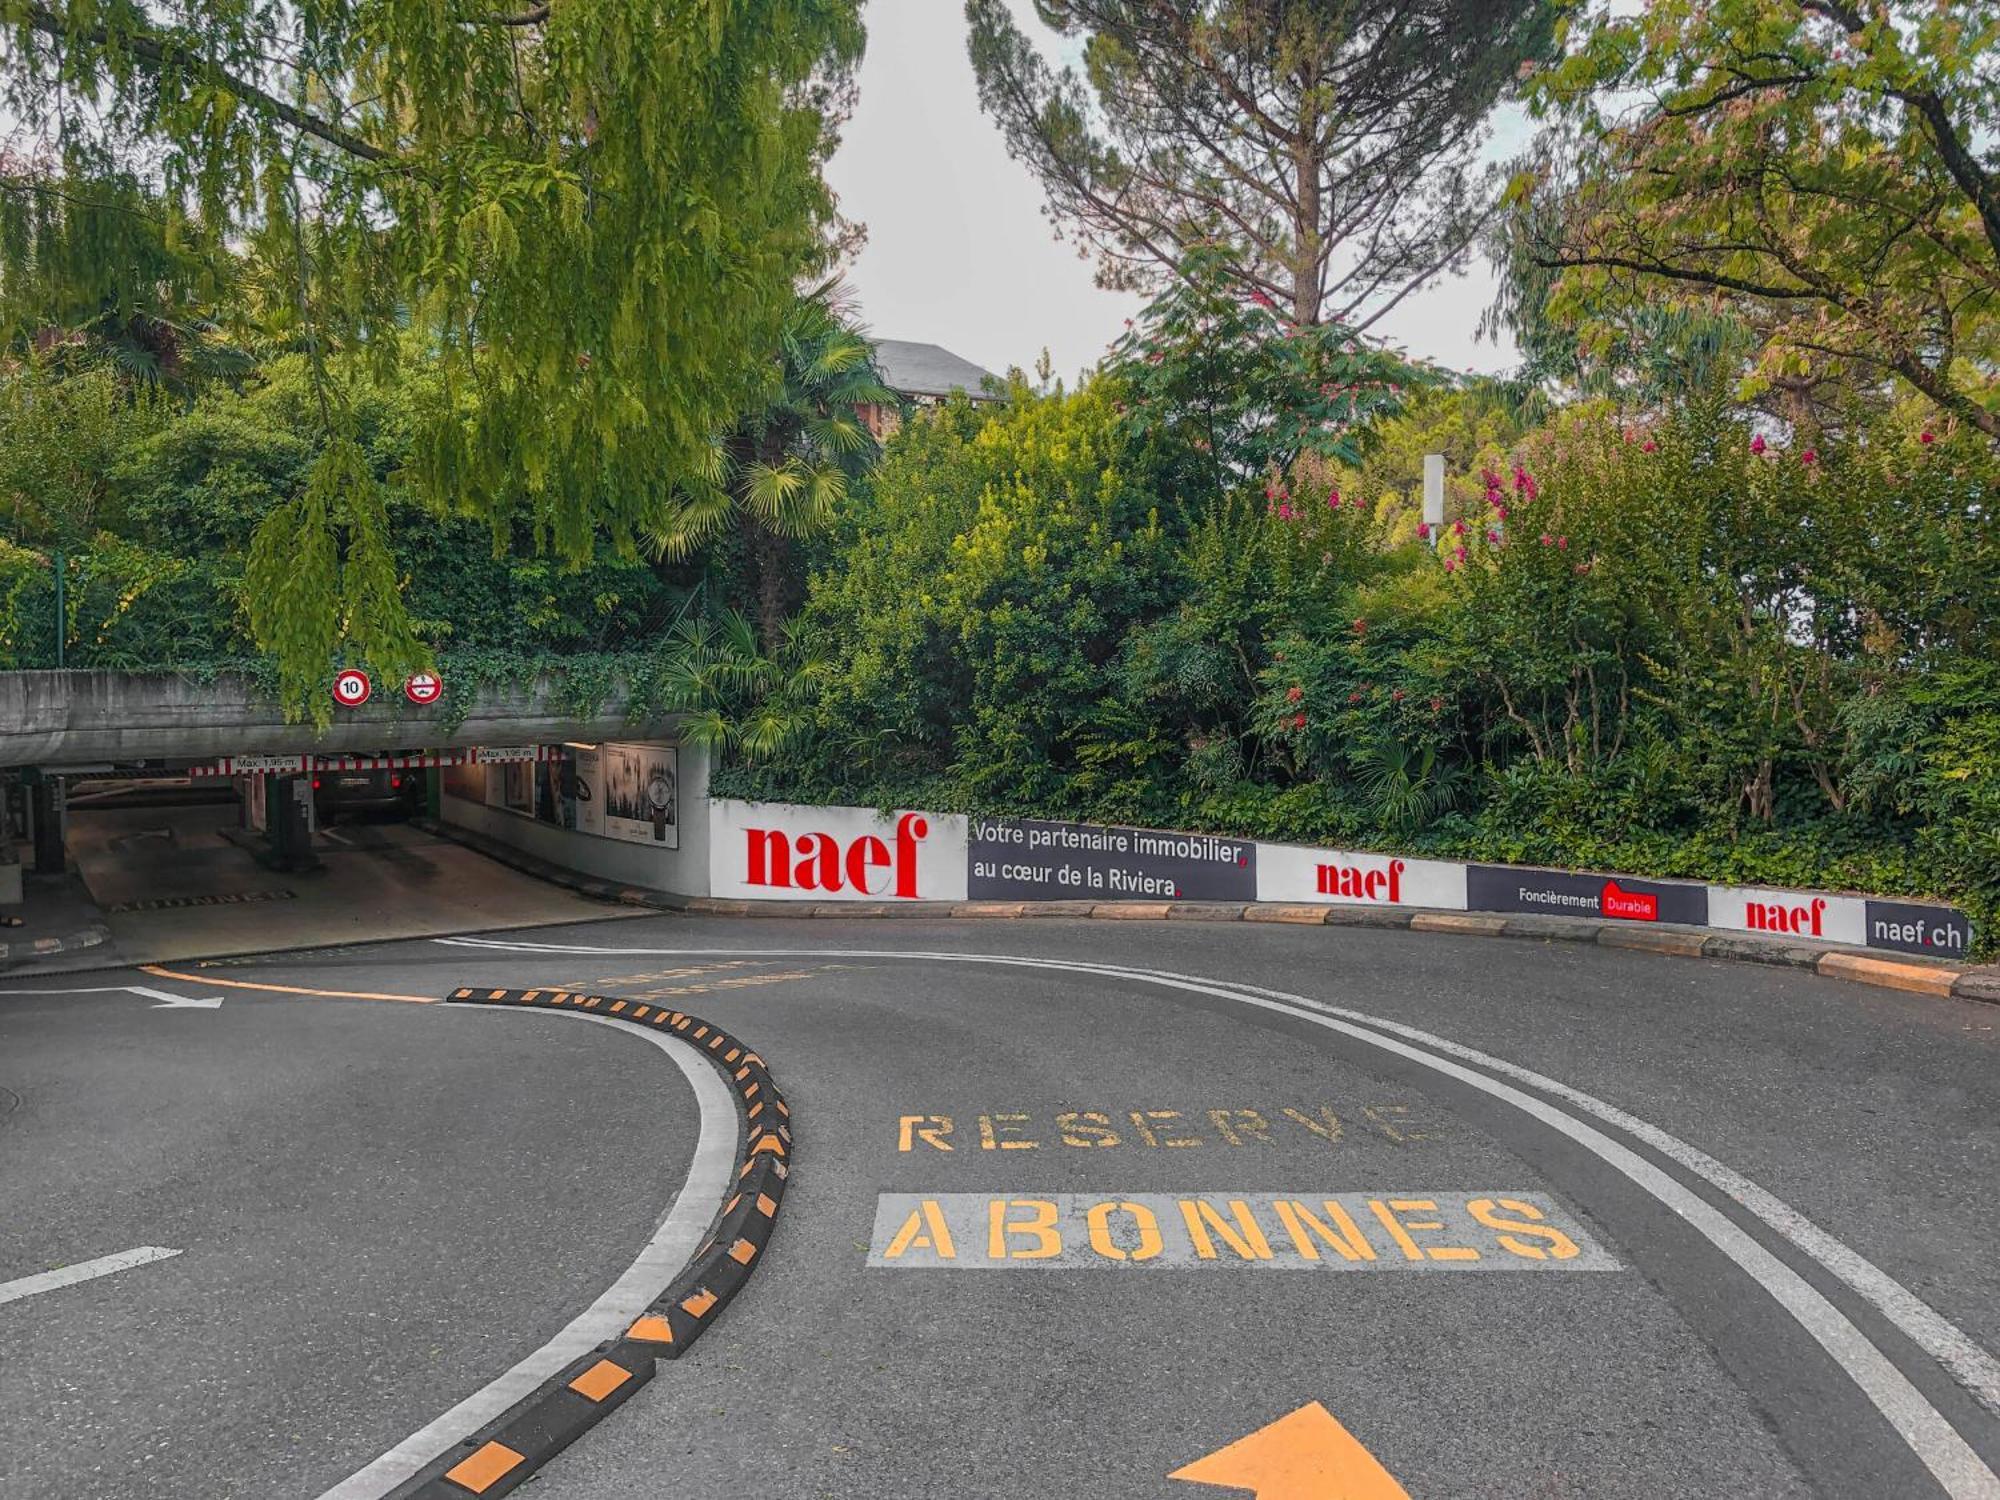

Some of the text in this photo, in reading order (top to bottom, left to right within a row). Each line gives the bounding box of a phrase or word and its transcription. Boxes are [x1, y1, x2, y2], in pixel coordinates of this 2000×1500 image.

[343, 680, 359, 694] 10
[741, 812, 928, 899] naef
[975, 822, 1024, 844] Votre
[1029, 827, 1128, 853] partenaire
[974, 862, 1182, 897] au cœur de la Riviera.
[1317, 860, 1405, 903] naef
[1519, 887, 1651, 914] Foncièrement Durable
[1746, 898, 1826, 937] naef
[1875, 919, 1962, 949] naef.ch
[897, 1105, 1438, 1153] RESERVE
[884, 1199, 1580, 1261] ABONNES
